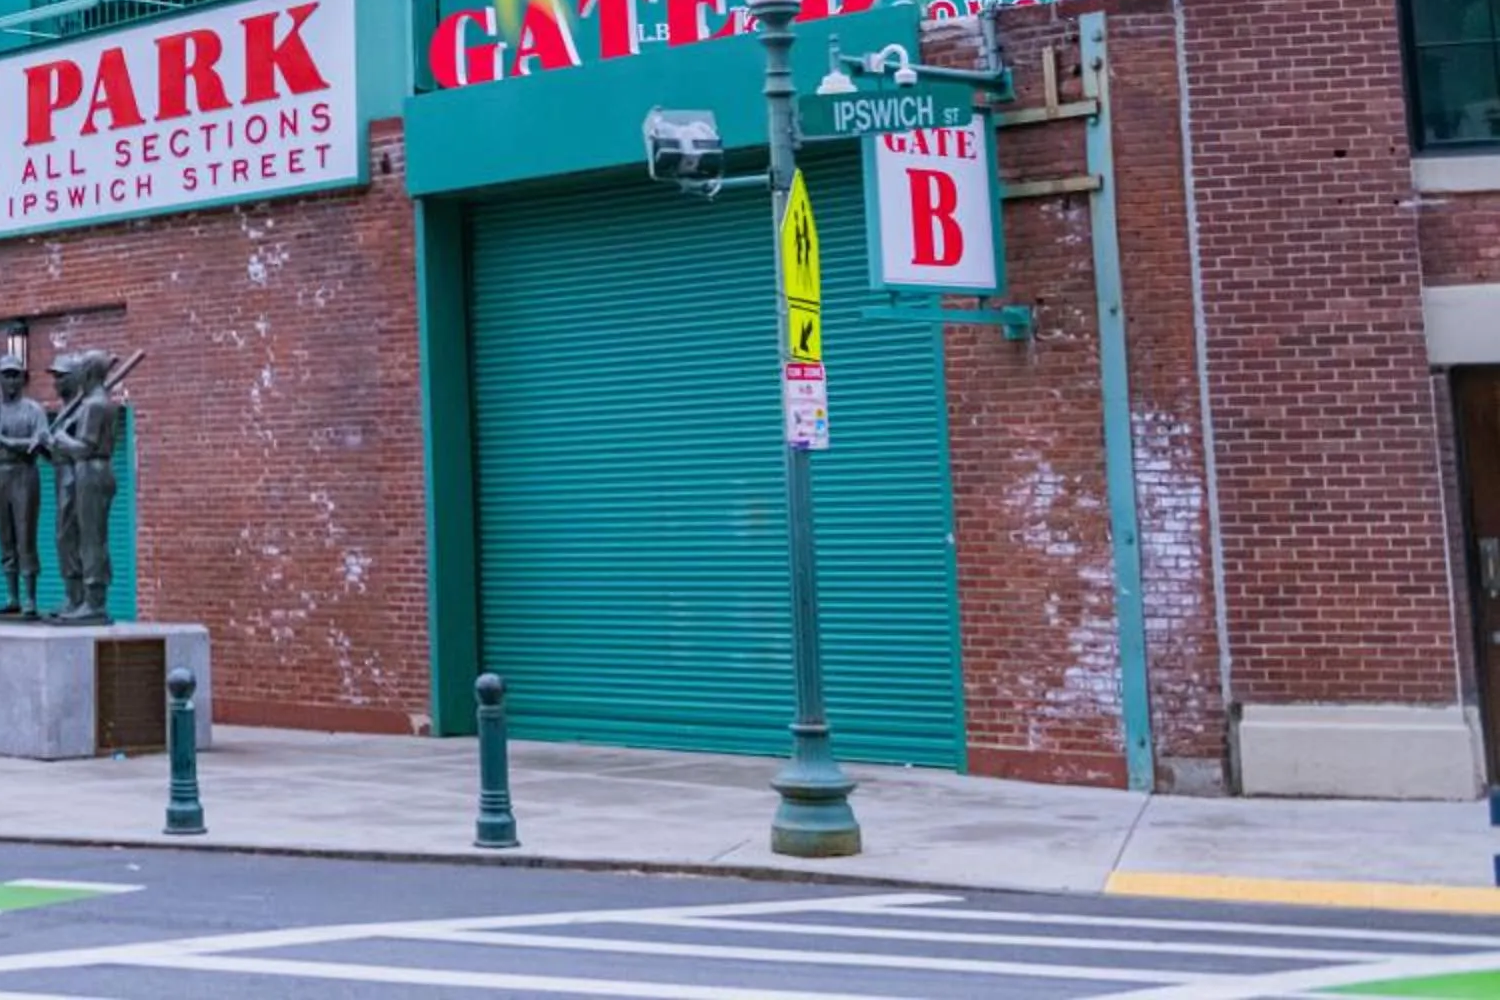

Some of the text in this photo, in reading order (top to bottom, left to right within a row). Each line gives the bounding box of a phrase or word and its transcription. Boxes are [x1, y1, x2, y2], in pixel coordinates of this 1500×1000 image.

[22, 1, 332, 147] PARK
[833, 95, 960, 132] IPSWICH ST
[8, 173, 153, 218] IPSWICH
[182, 143, 332, 191] STREET
[21, 149, 87, 185] ALL
[114, 102, 332, 168] SECTIONS
[883, 127, 977, 160] GATE
[905, 167, 964, 267] B
